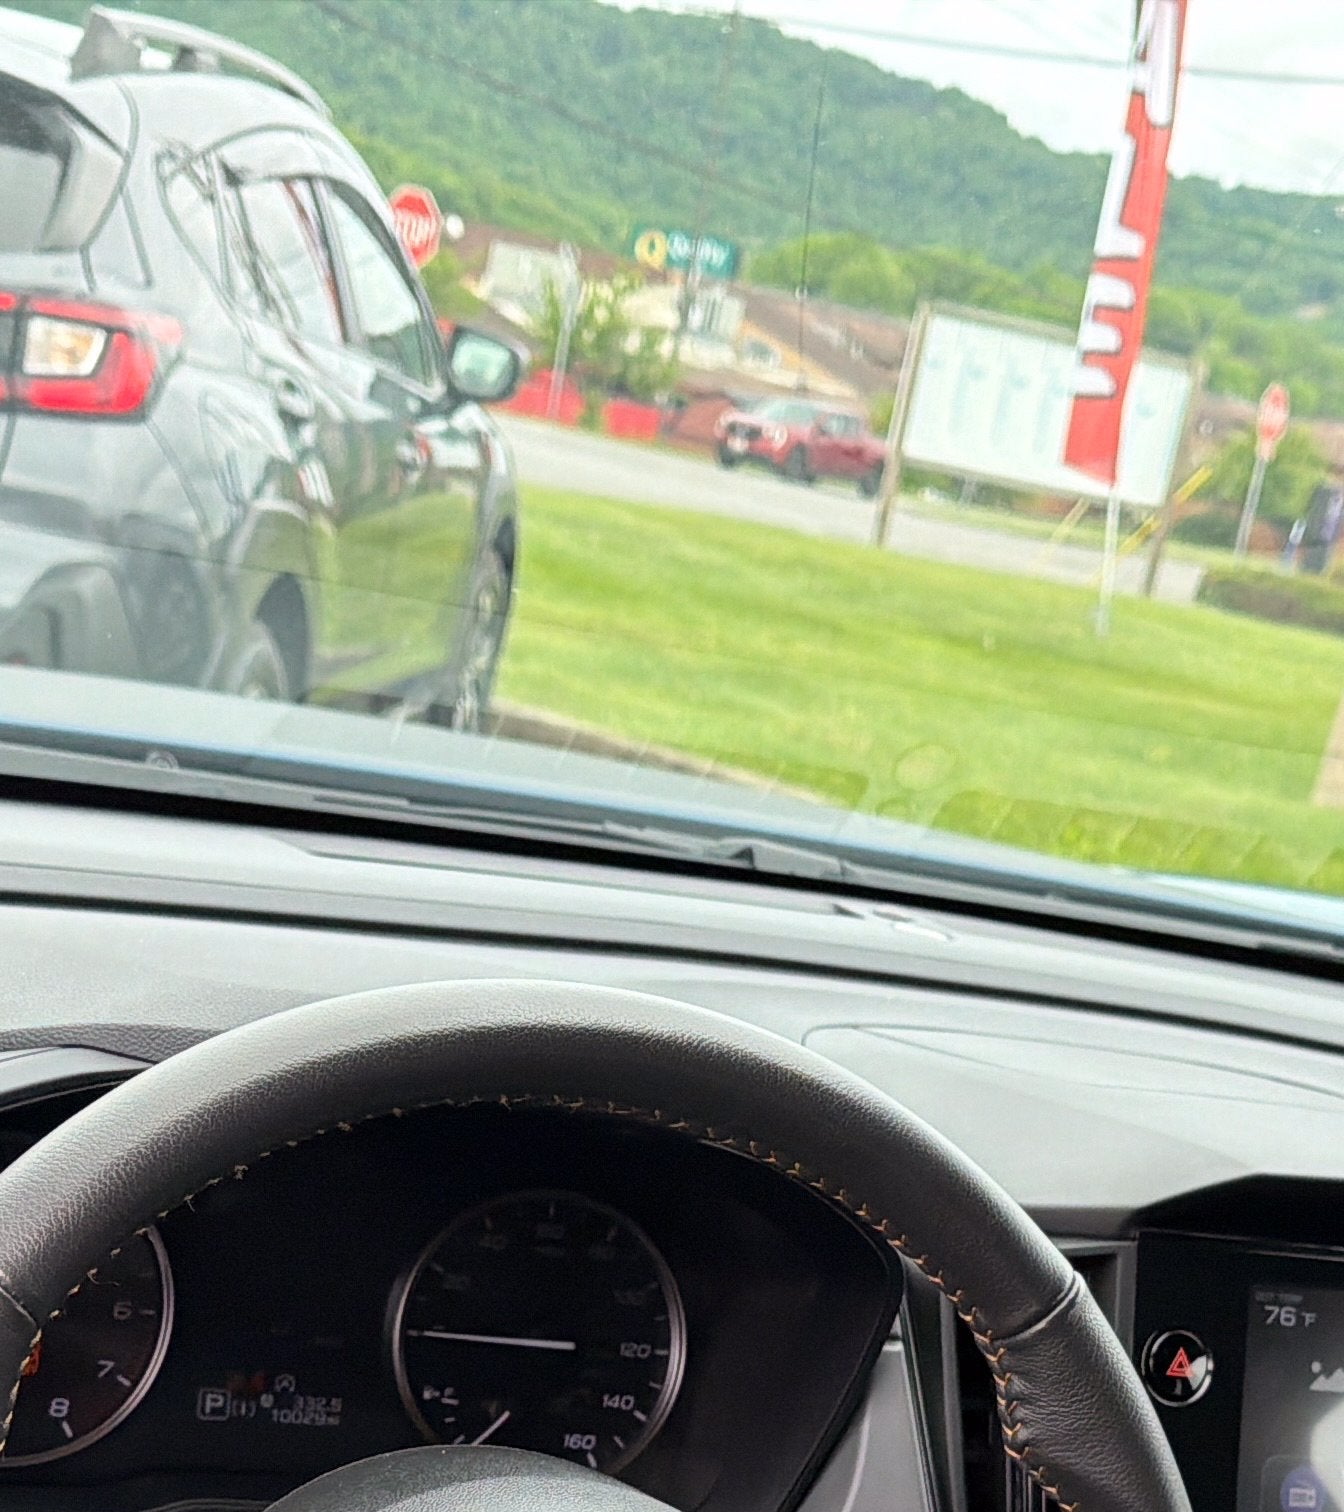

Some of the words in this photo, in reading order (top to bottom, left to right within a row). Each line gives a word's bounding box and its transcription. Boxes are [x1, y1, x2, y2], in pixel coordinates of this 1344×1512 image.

[1264, 1305, 1297, 1328] 76
[619, 1341, 652, 1359] 120
[96, 1359, 116, 1379] 7
[48, 1397, 71, 1418] 8
[206, 1393, 225, 1415] P
[602, 1394, 635, 1411] 140
[563, 1433, 597, 1451] 160
